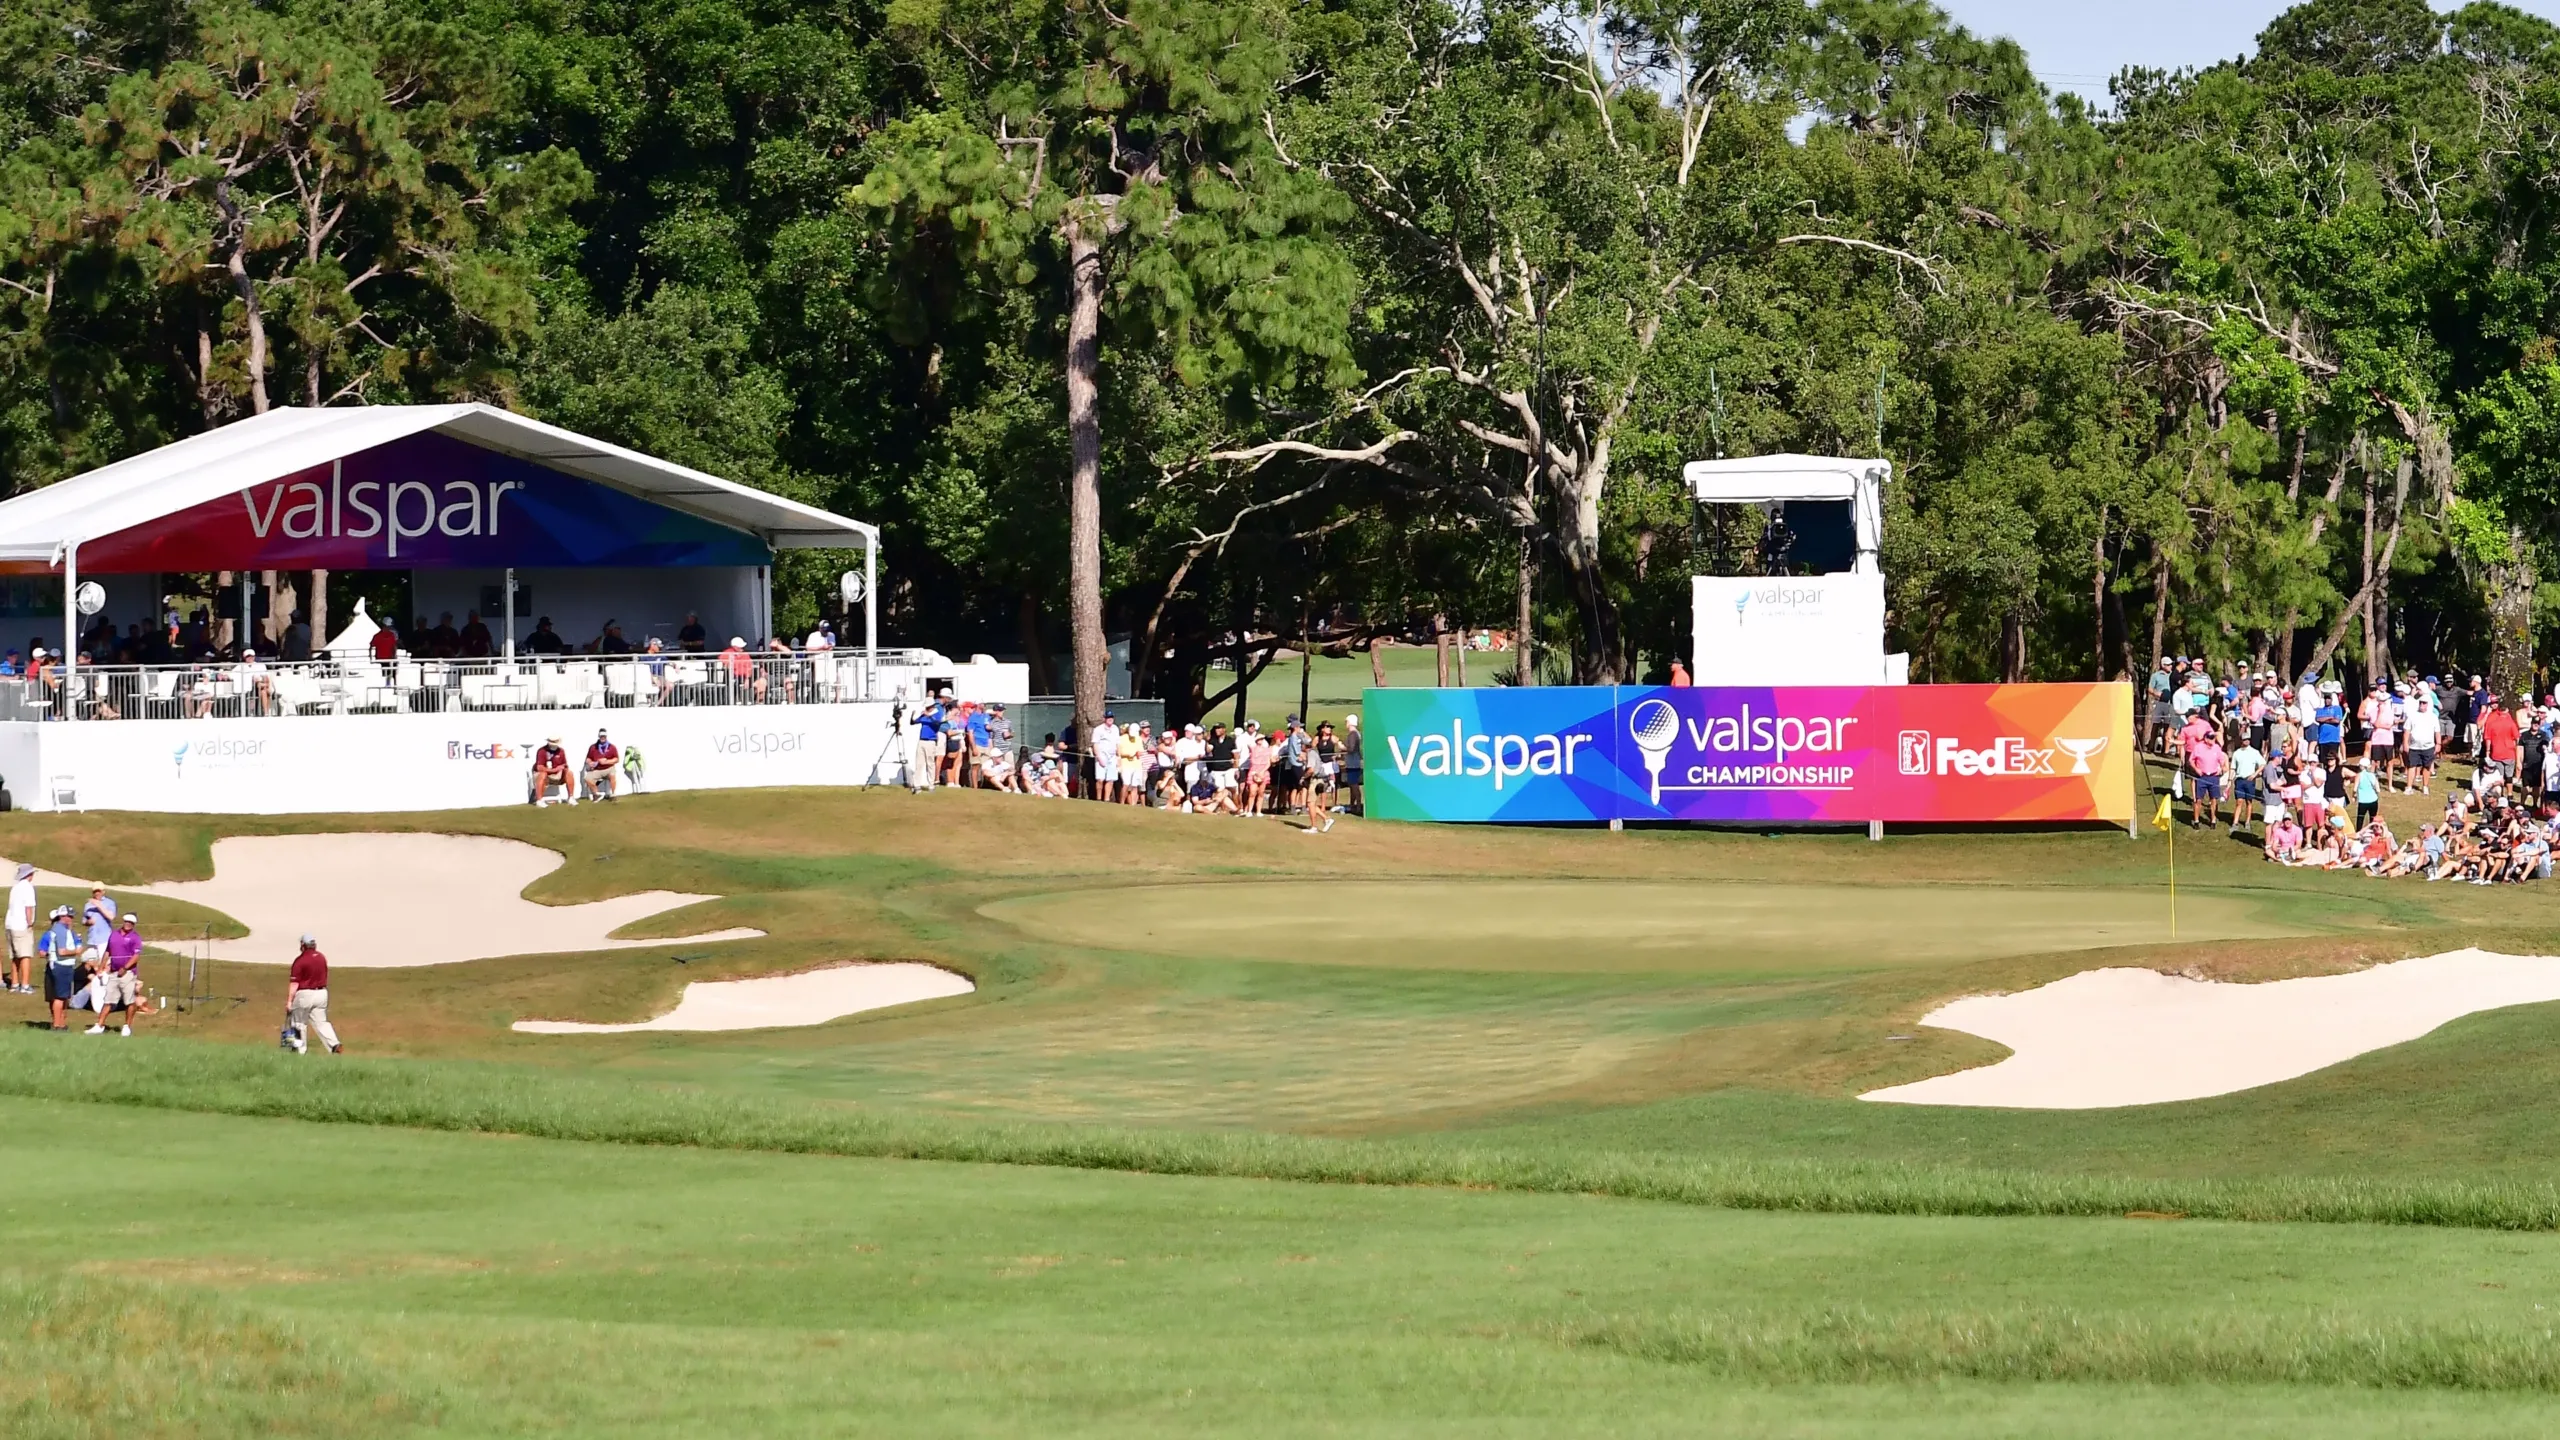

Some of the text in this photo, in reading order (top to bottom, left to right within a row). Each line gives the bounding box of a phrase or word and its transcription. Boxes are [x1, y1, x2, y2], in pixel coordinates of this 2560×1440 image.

[240, 458, 516, 558] valspar
[1754, 583, 1825, 609] valspar
[193, 734, 267, 761] valspar
[712, 726, 806, 759] valspar
[1686, 703, 1853, 764] valspar
[464, 743, 515, 760] FedEx
[1387, 717, 1587, 791] valspar
[1936, 736, 2056, 776] FedEx
[1687, 765, 1854, 785] CHAMPIONSHIP
